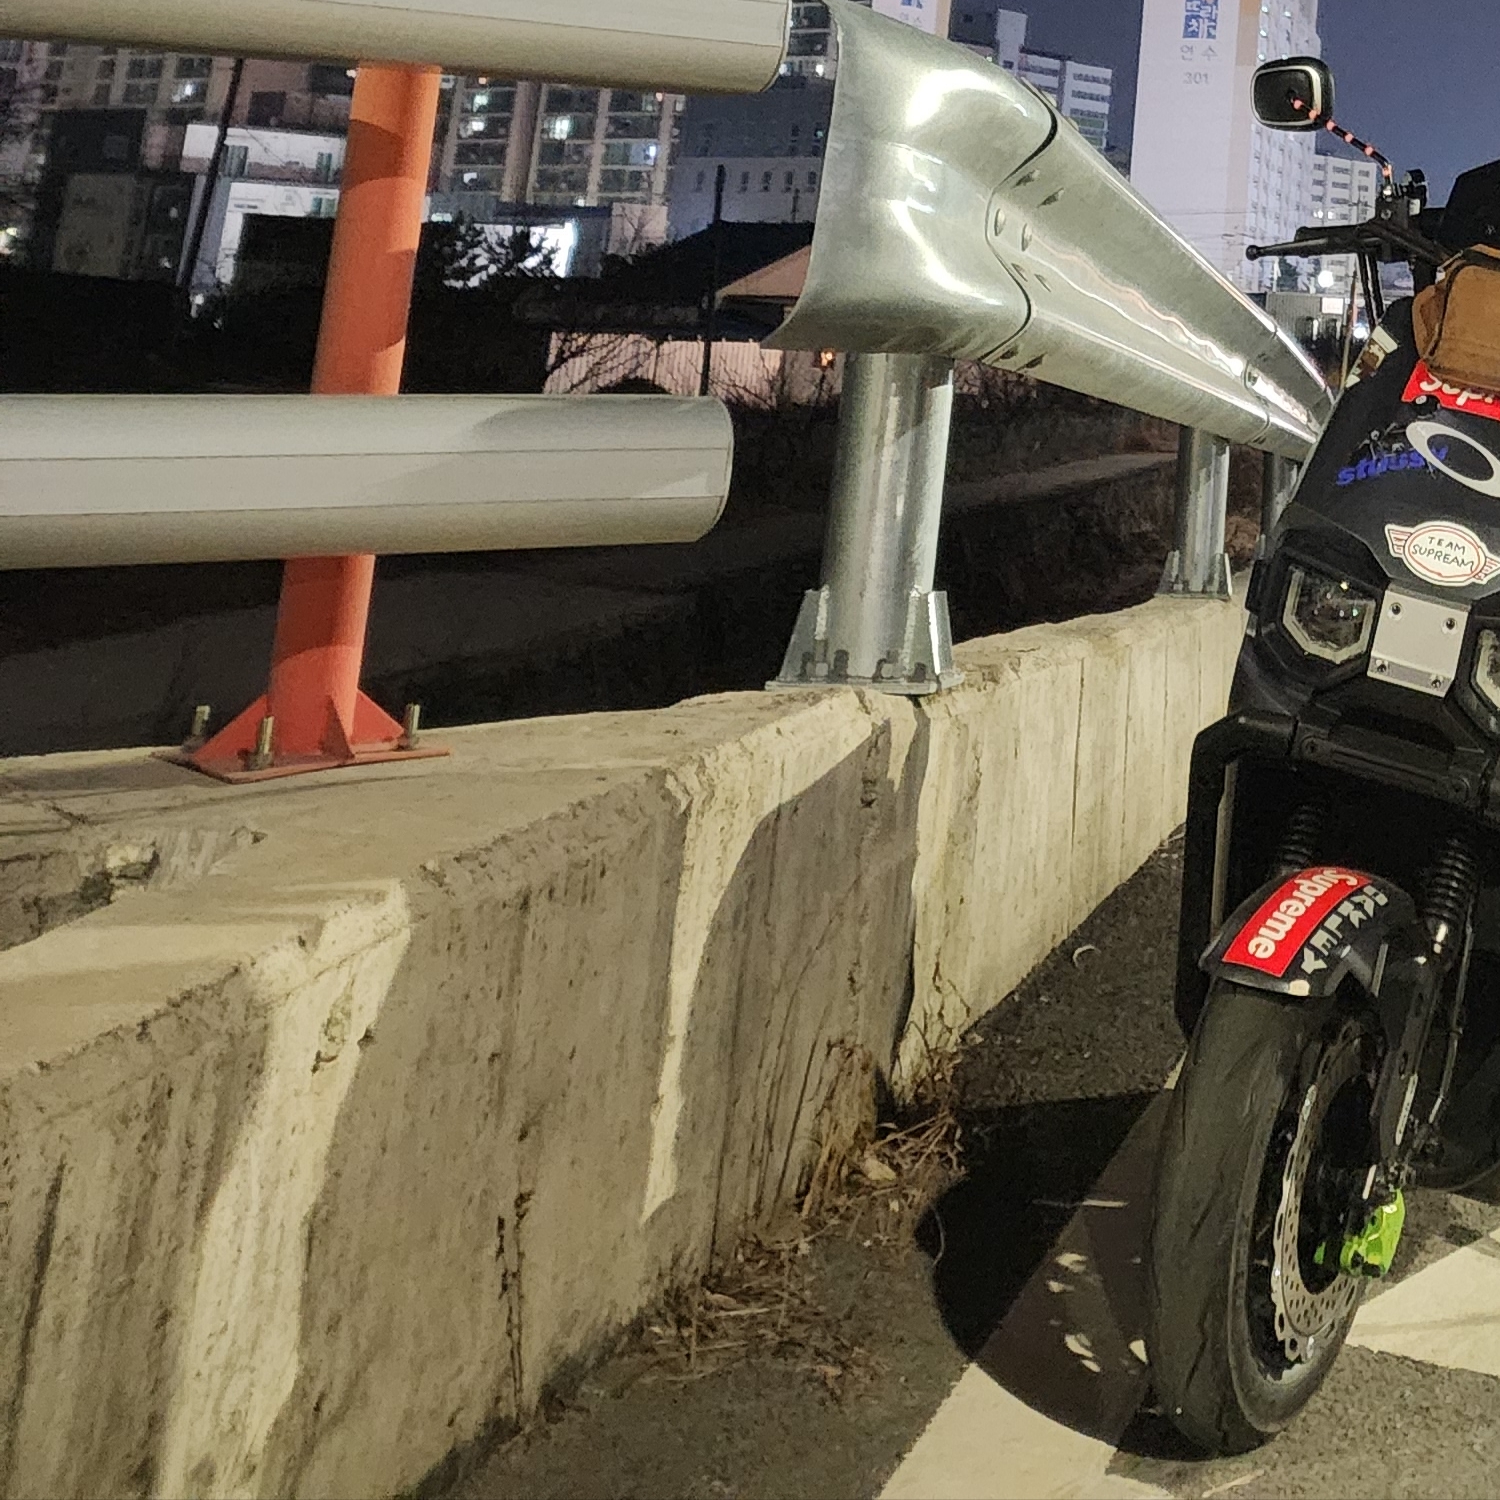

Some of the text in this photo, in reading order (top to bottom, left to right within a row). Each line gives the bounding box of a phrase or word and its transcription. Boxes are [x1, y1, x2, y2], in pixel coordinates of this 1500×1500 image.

[1411, 543, 1475, 573] SUPREAM
[1427, 536, 1467, 555] TEAM
[1247, 868, 1359, 960] Supreme
[1300, 884, 1389, 975] OAKLEY
